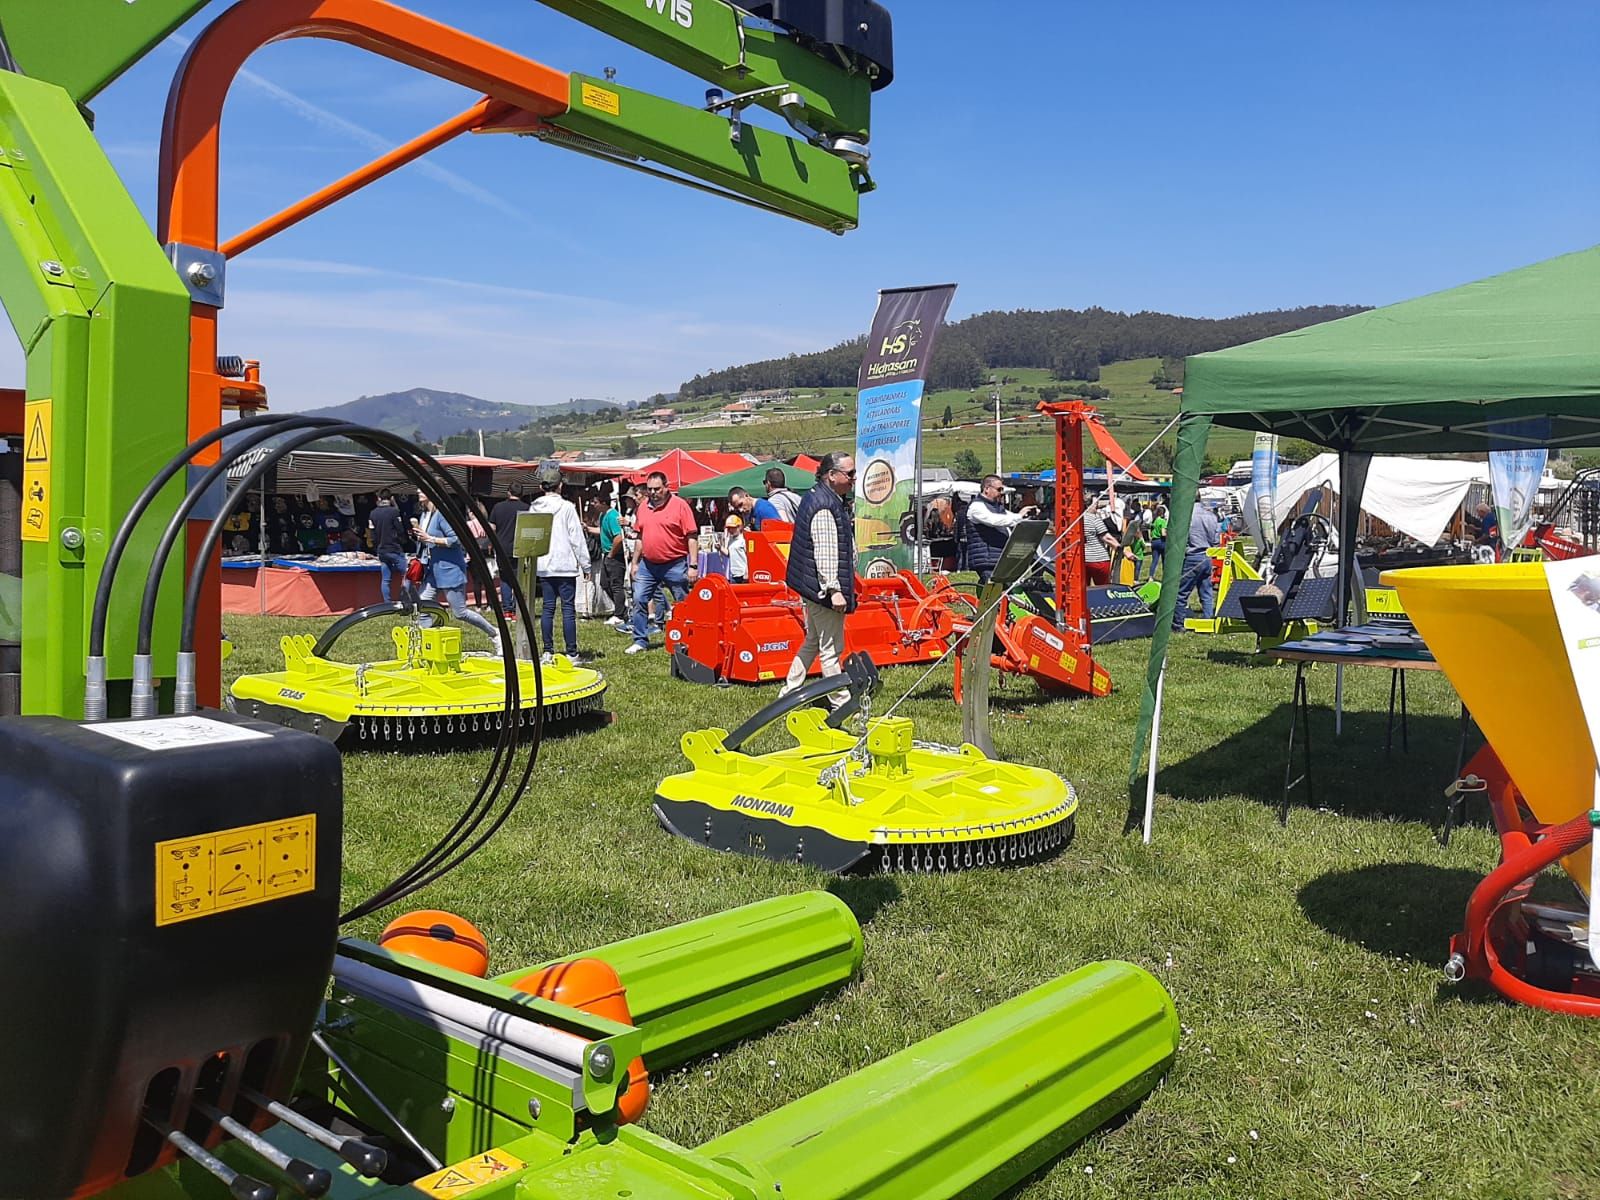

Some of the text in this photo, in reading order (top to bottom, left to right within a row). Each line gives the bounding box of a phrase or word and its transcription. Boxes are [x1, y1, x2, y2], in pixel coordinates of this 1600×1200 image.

[880, 334, 907, 356] HS
[868, 358, 917, 375] Hidrasam
[761, 641, 789, 652] JGN
[278, 688, 306, 700] TEXAS
[730, 794, 795, 818] MONTANA
